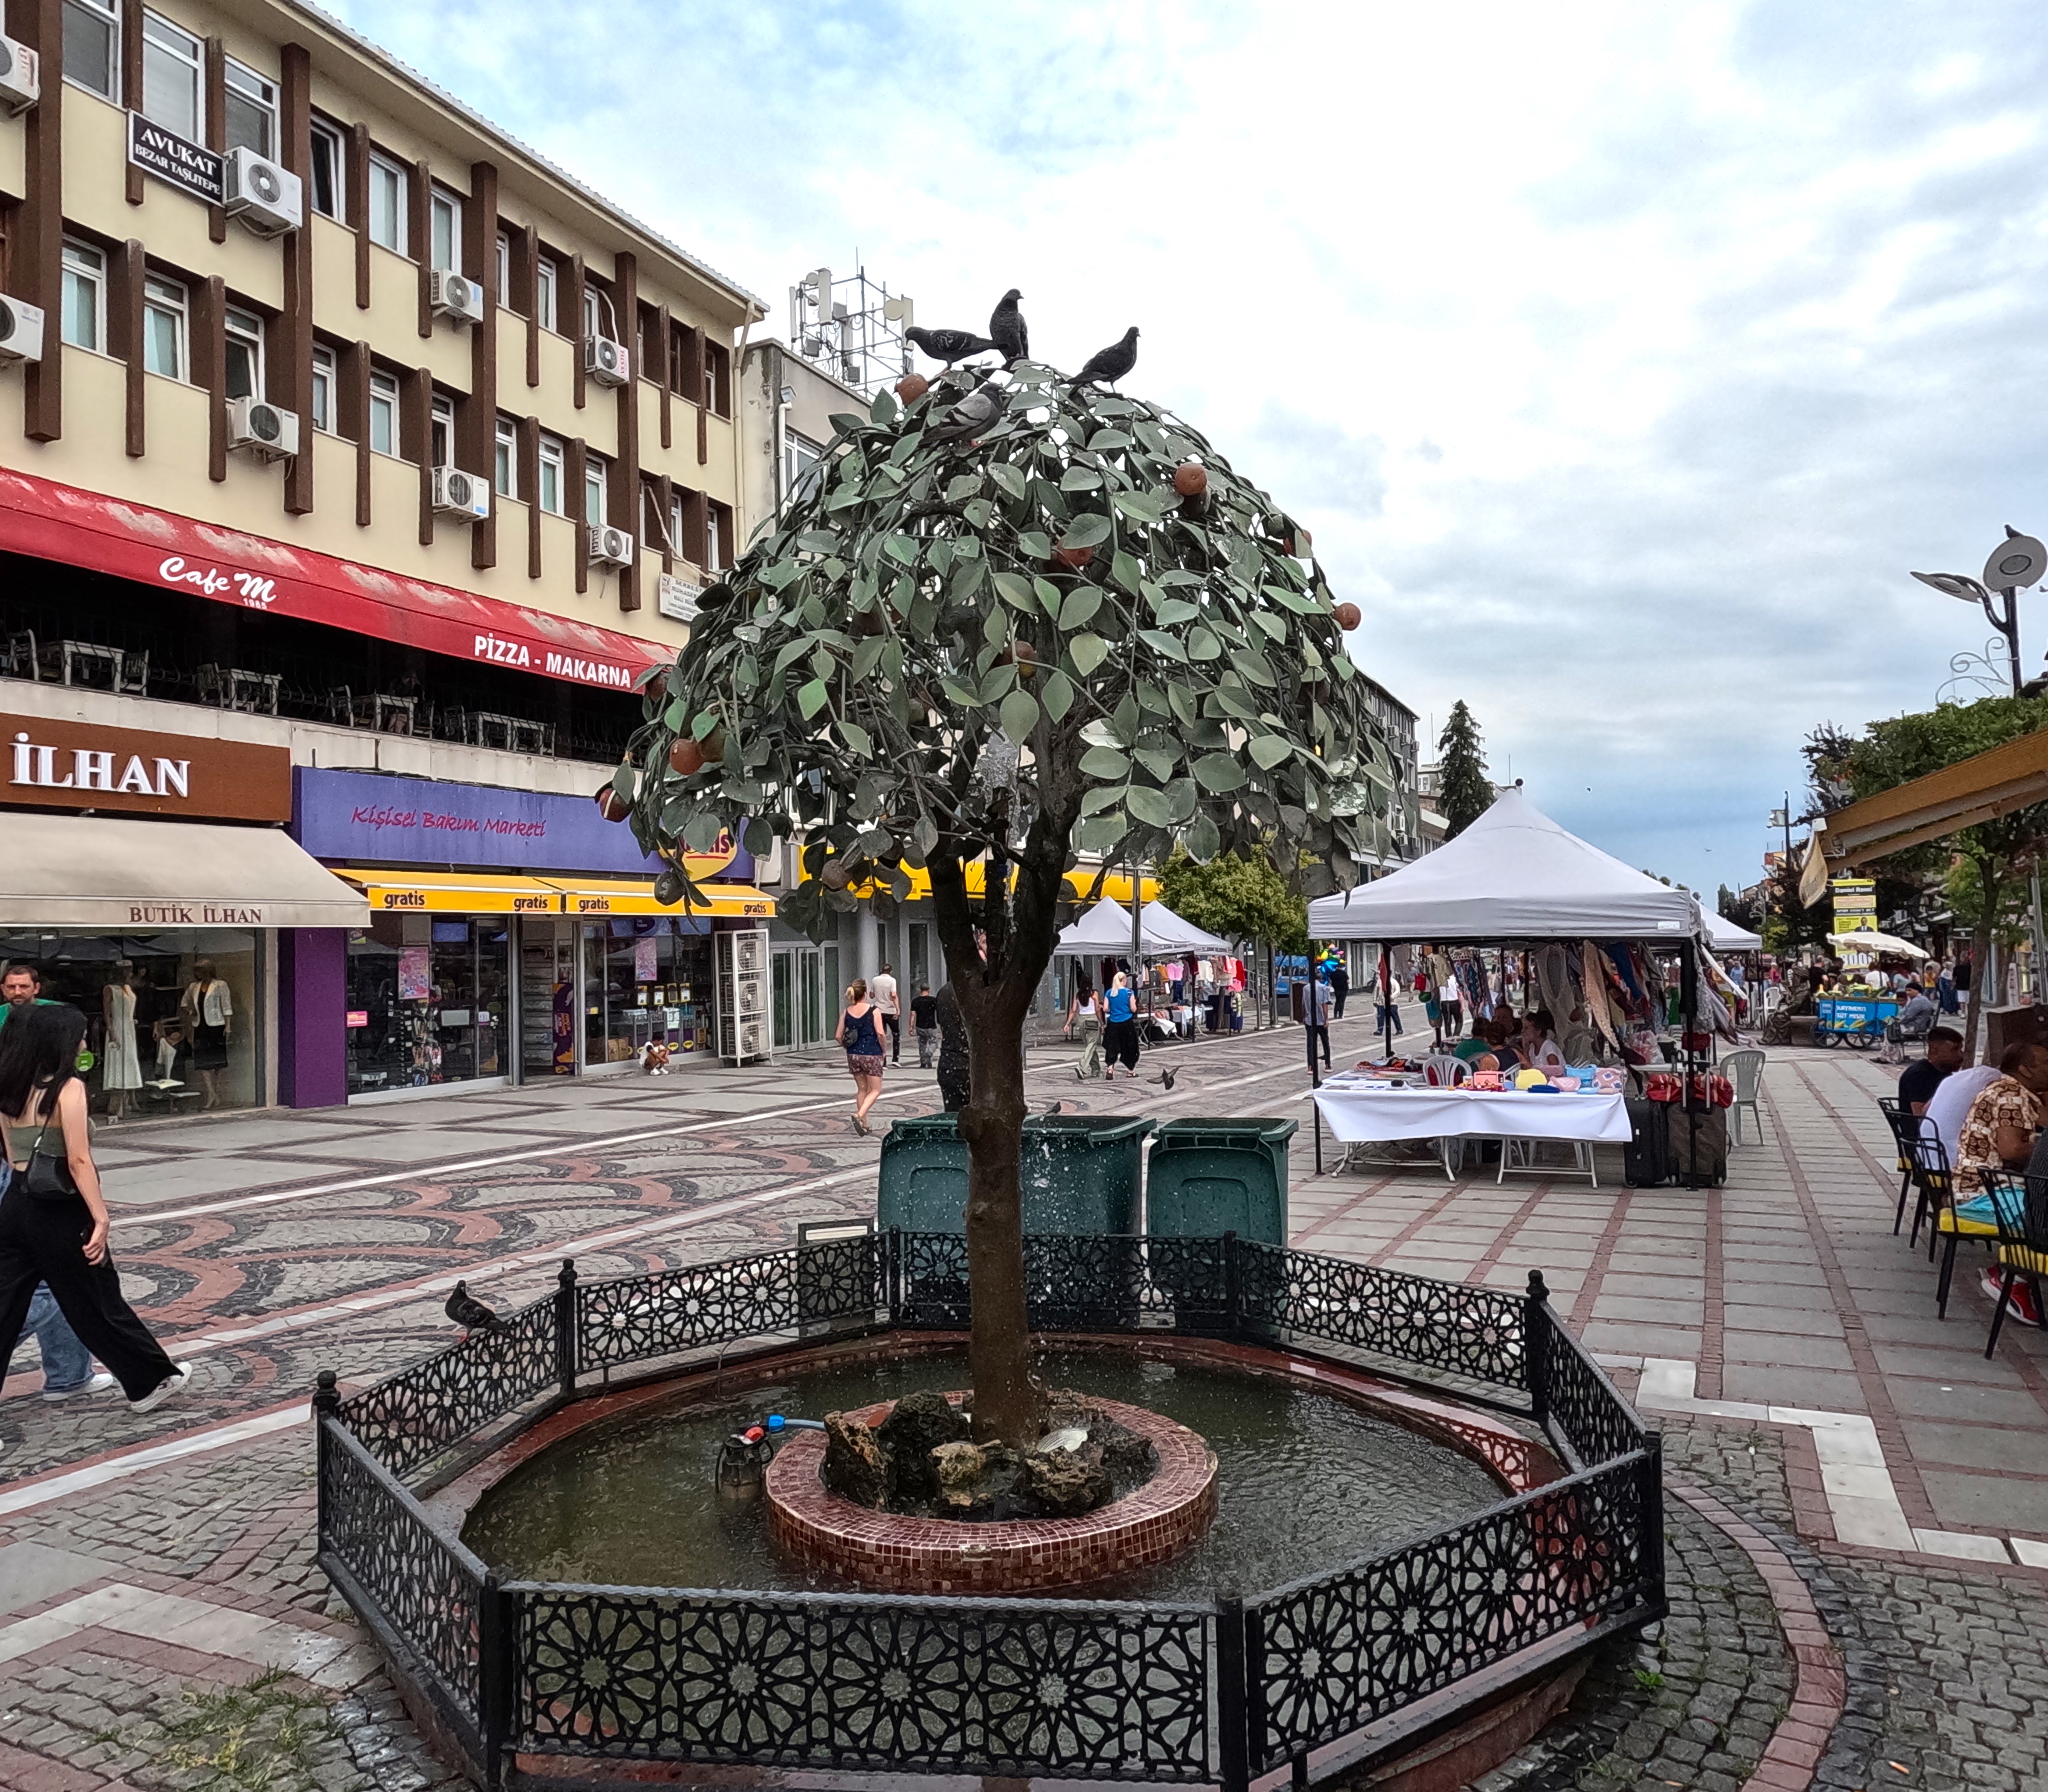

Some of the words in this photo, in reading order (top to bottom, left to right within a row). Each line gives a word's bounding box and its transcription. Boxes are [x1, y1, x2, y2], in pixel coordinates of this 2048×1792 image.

[141, 128, 217, 176] AVUKAT
[135, 144, 168, 169] BEZAR
[170, 161, 221, 195] TAŞLITEPE
[160, 557, 230, 594] Cafe
[234, 573, 277, 602] M
[474, 632, 530, 667] PİZZA
[546, 652, 631, 688] MAKARNA
[8, 732, 191, 797] İLHAN
[351, 804, 417, 831] Kişisel
[422, 812, 480, 832] Bakım
[484, 817, 547, 838] Marketi
[129, 904, 195, 923] BUTİK
[203, 905, 262, 923] İLHAN
[384, 890, 425, 909] gratis
[514, 895, 548, 911] gratis
[579, 896, 609, 912] gratis
[744, 902, 767, 915] gratis
